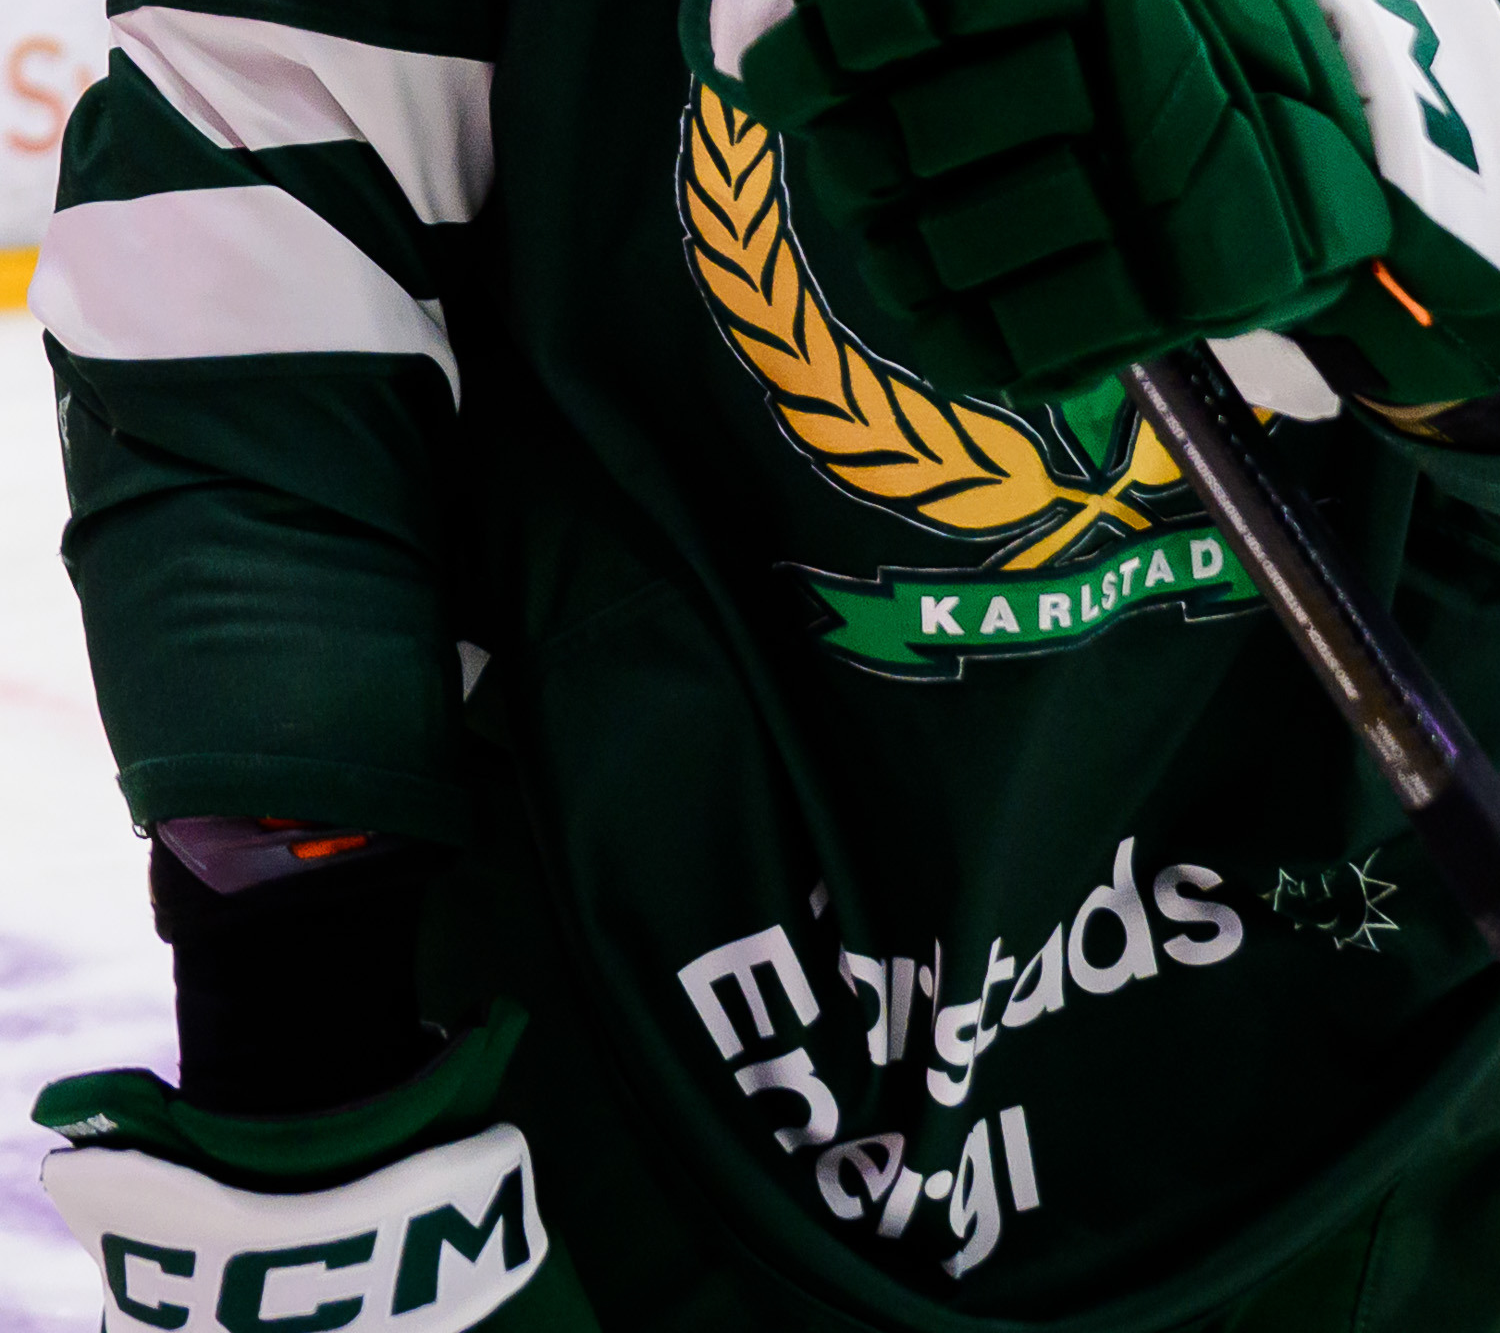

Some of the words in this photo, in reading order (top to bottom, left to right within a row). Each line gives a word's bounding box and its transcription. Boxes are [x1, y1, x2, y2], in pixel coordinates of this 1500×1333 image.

[1177, 437, 1252, 535] PROFESSIONAL
[918, 539, 1225, 636] KARLSTAD
[100, 1162, 531, 1333] CCM
